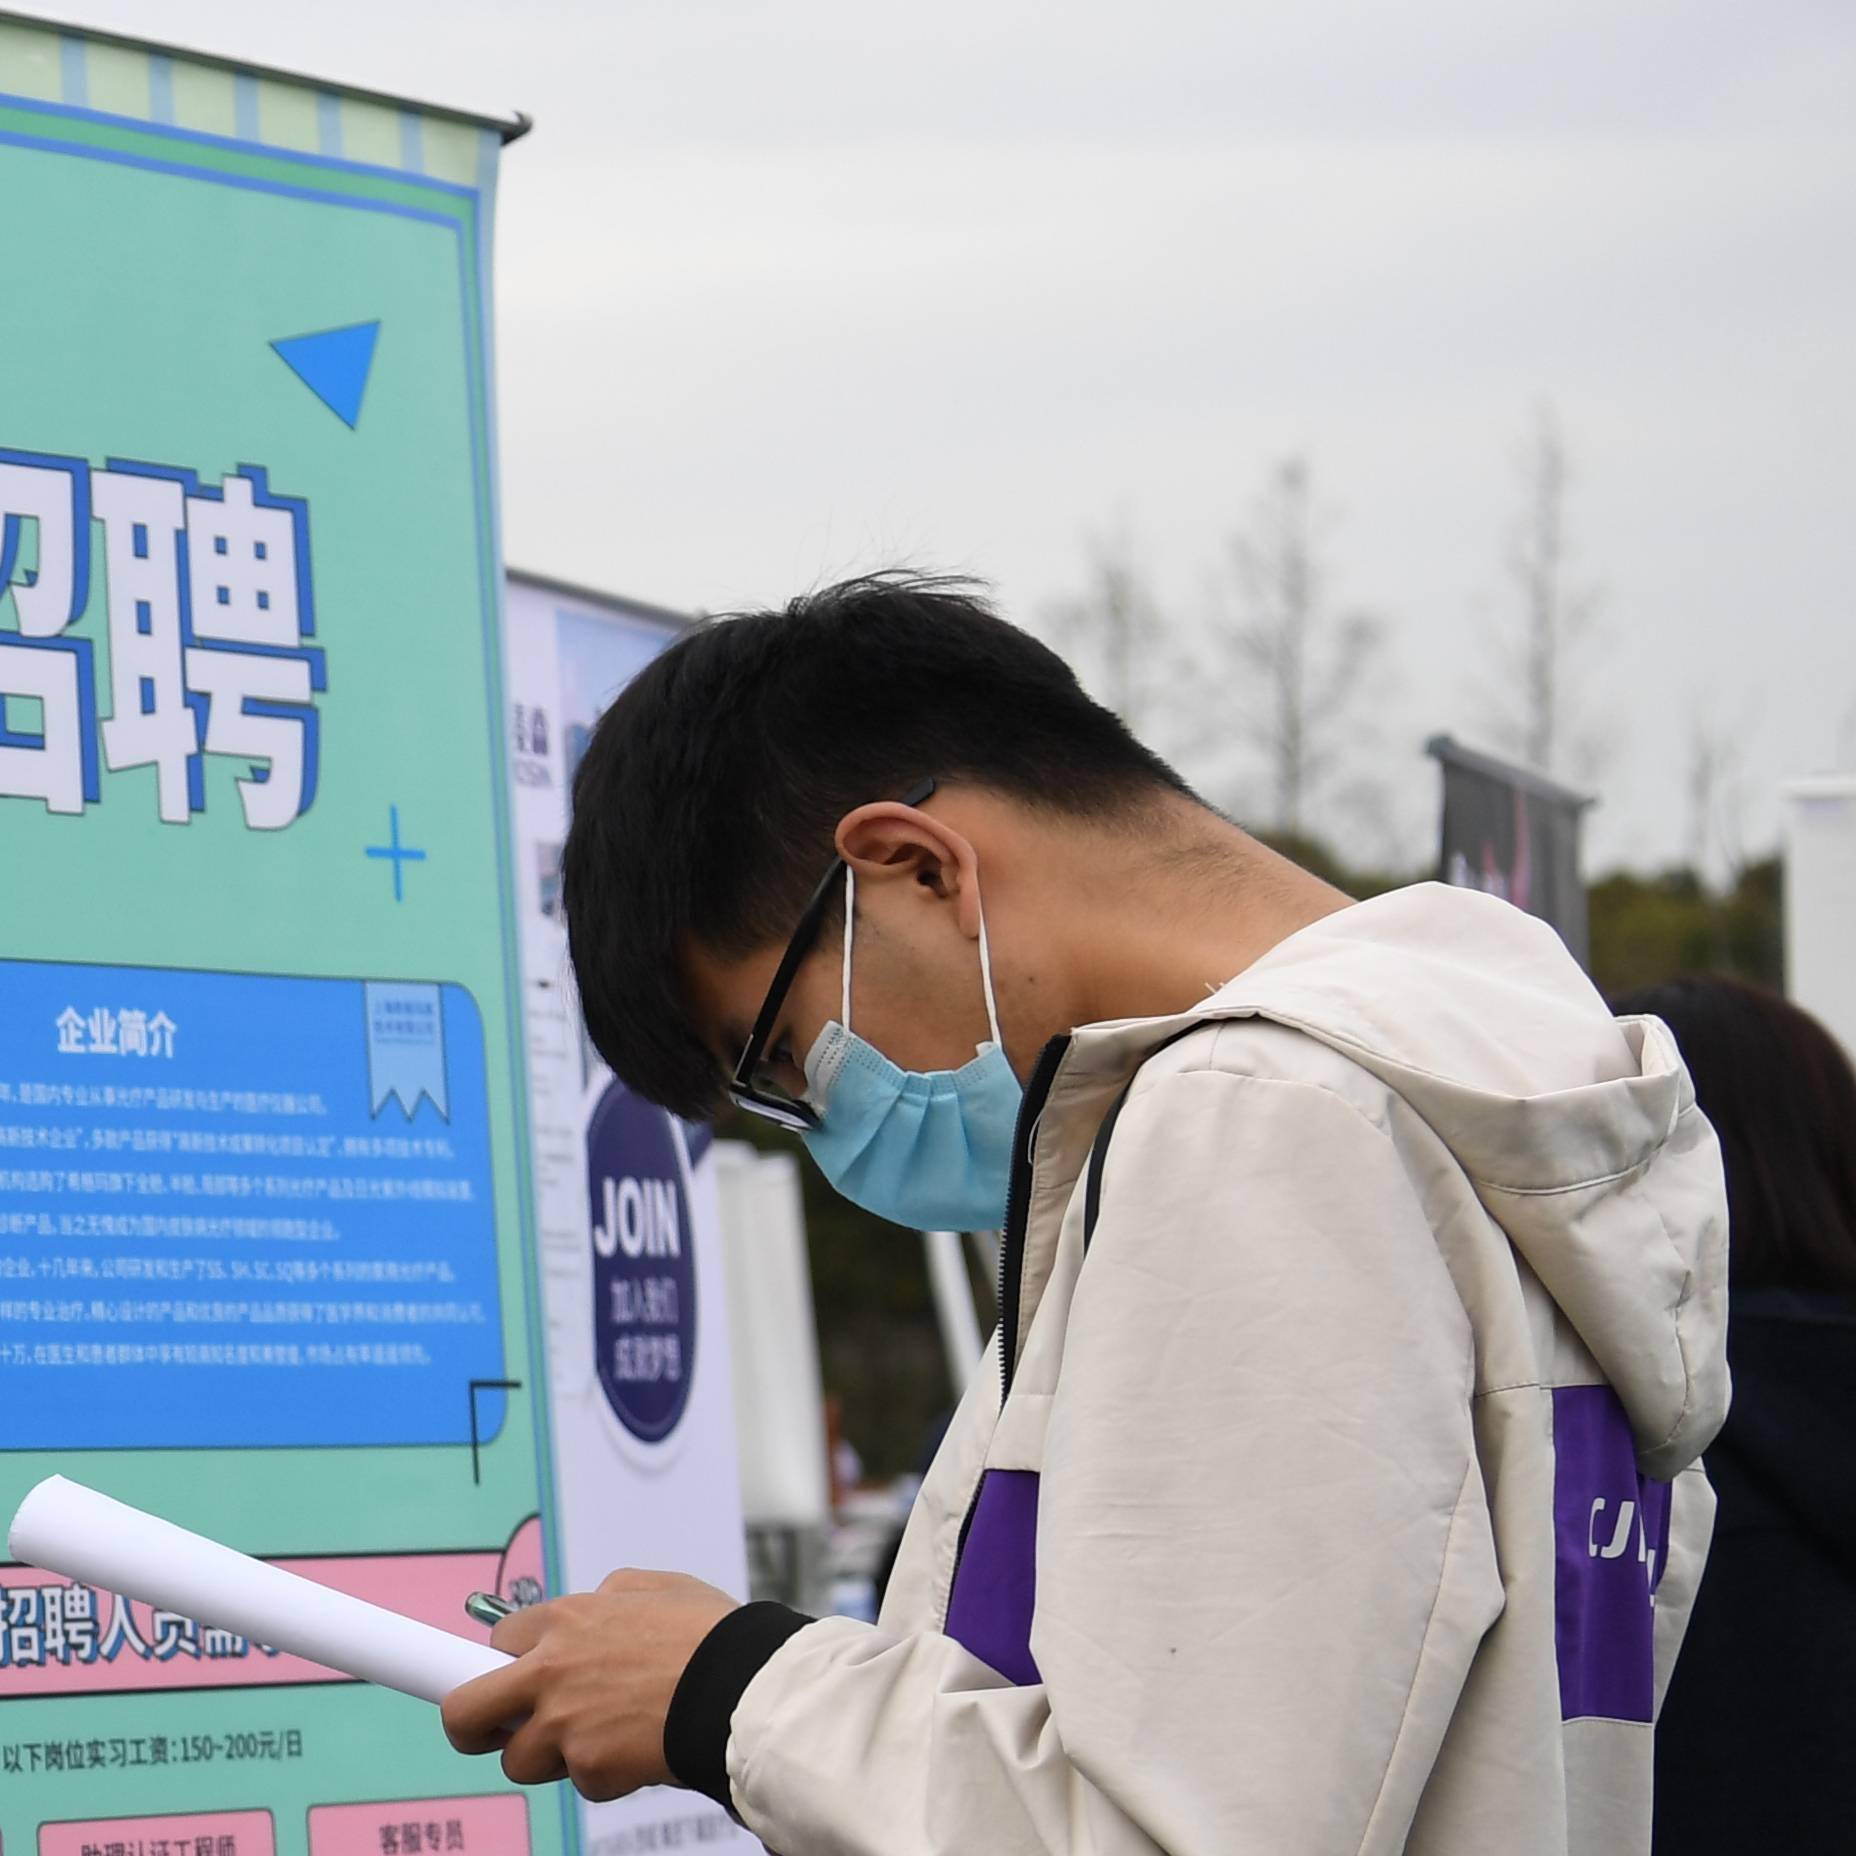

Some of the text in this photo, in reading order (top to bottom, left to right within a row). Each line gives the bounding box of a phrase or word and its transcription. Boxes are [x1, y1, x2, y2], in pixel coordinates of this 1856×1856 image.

[56, 1005, 176, 1058] 企业简介
[594, 1175, 682, 1258] JOIN
[379, 1819, 465, 1856] 客服专员
